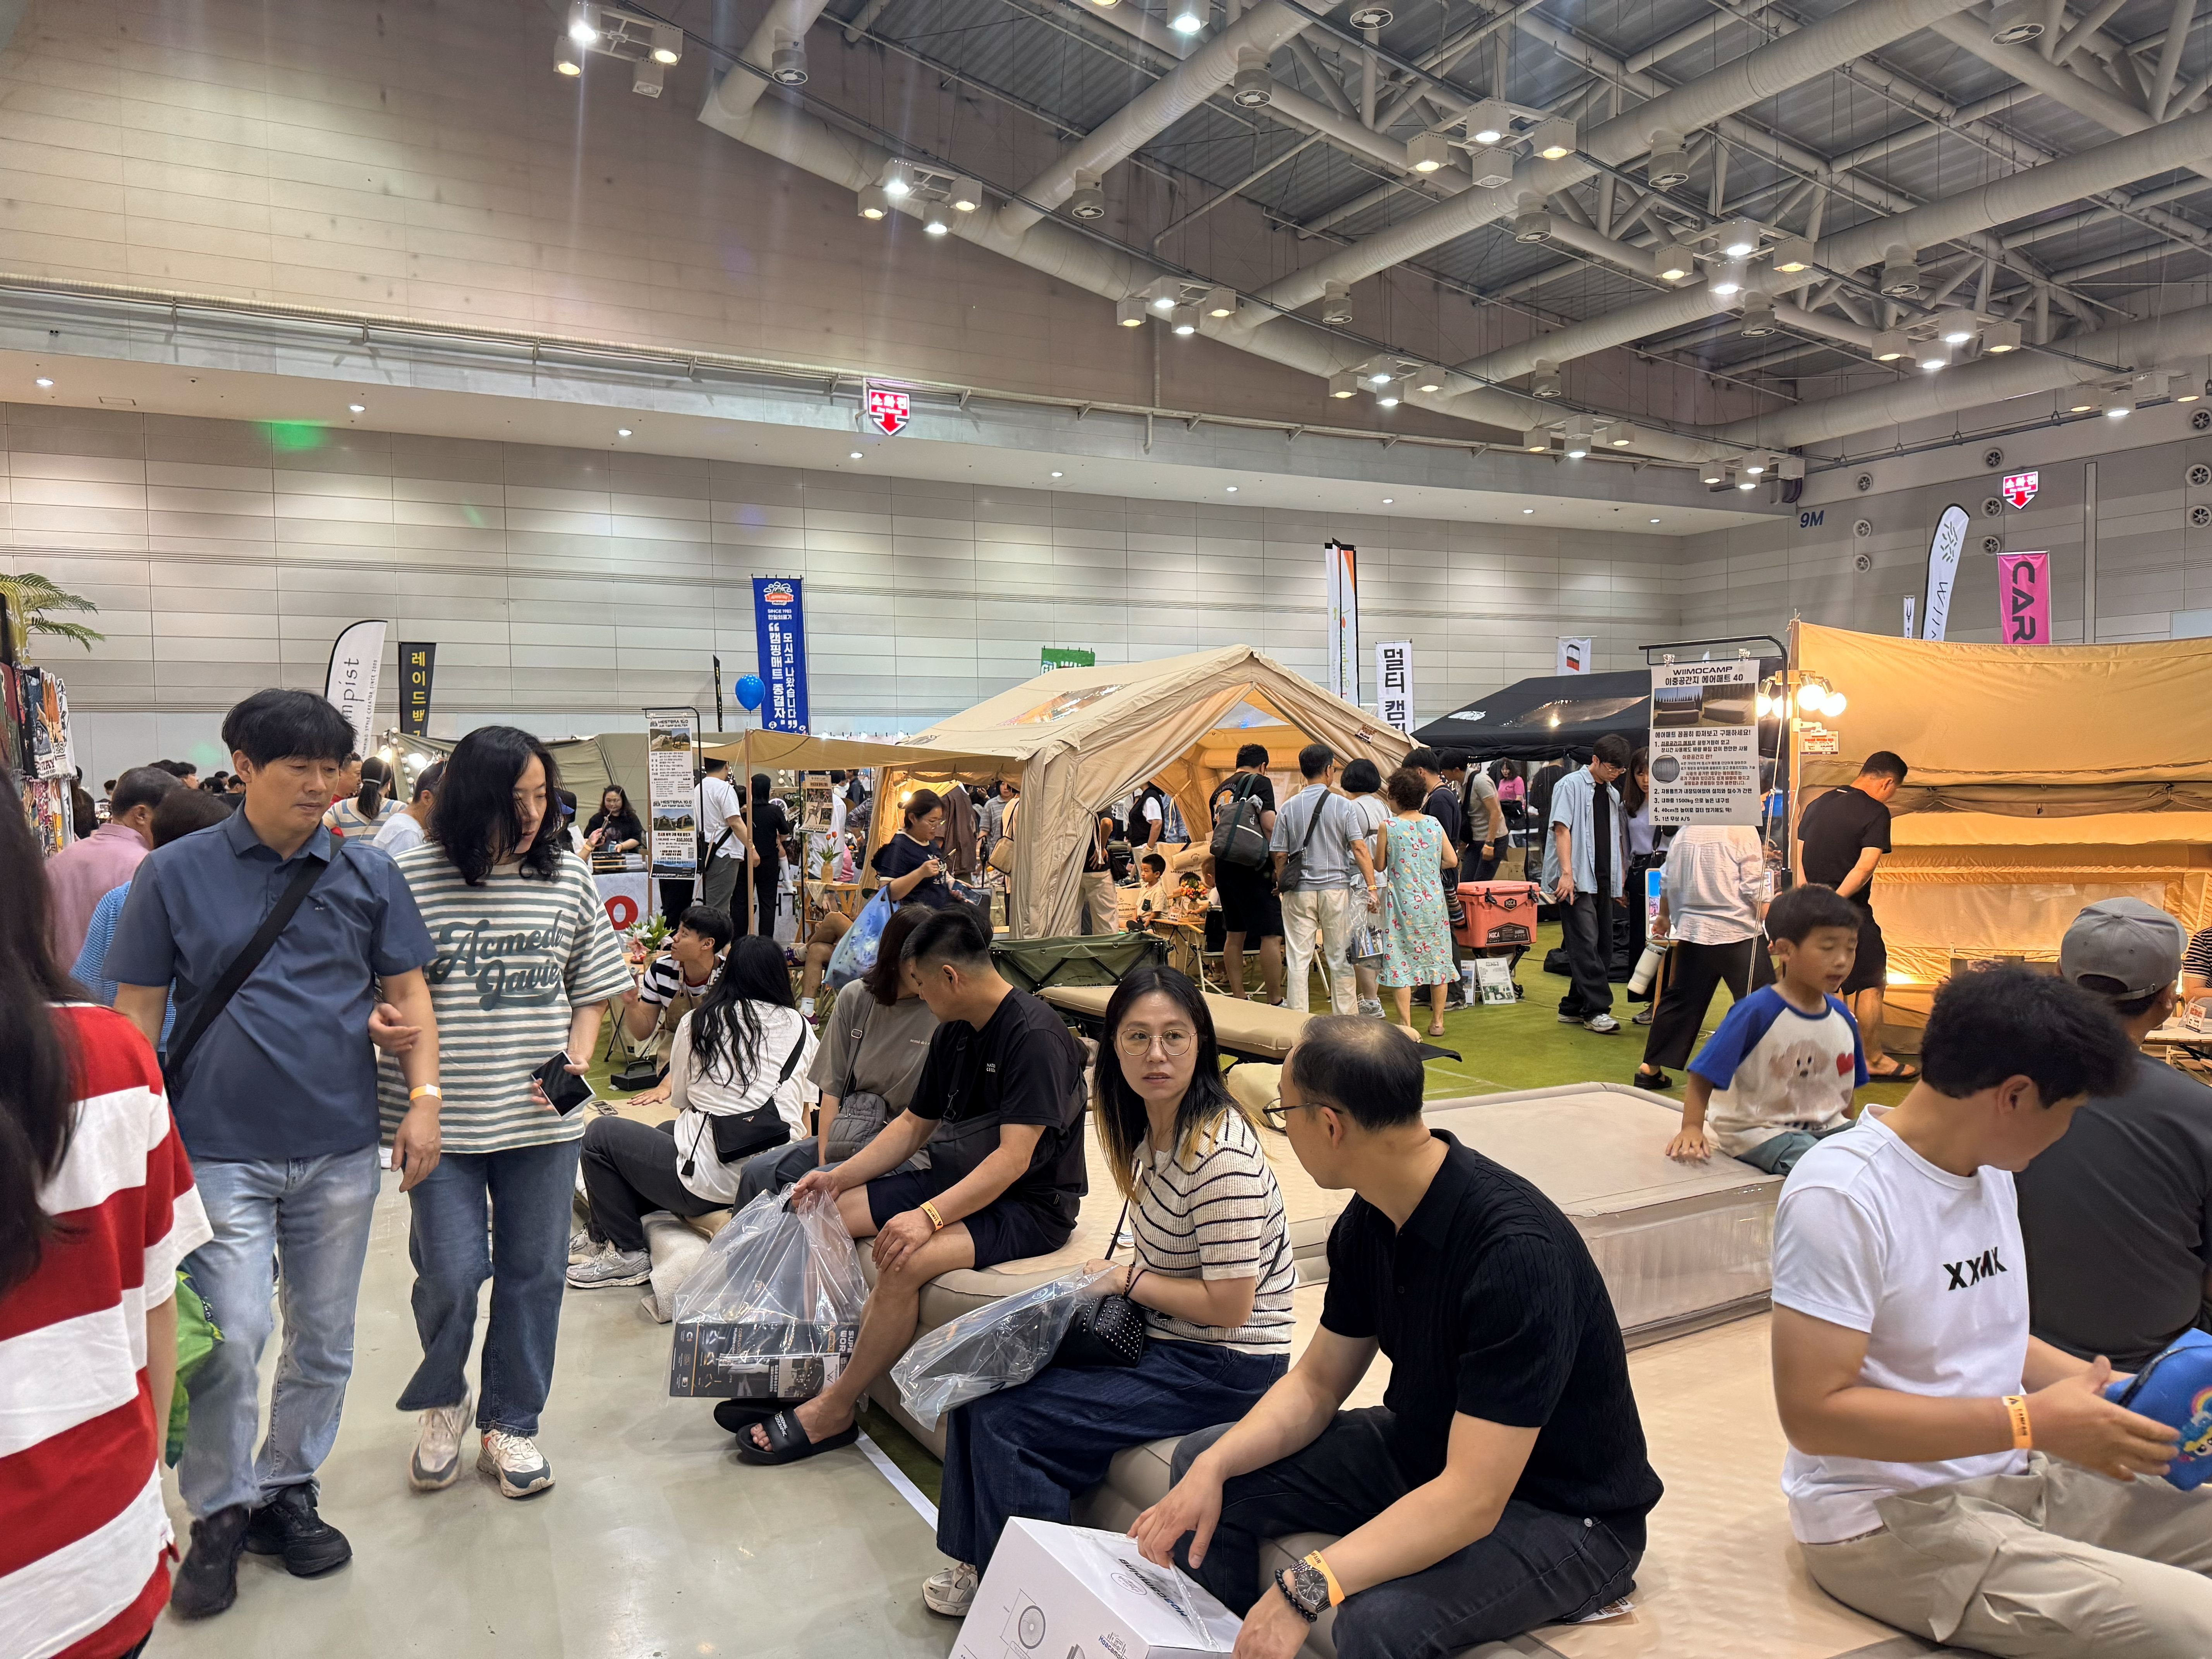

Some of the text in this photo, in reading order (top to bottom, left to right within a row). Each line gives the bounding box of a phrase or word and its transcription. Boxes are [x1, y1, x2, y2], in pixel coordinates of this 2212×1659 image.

[1800, 510, 1824, 528] 9M
[2012, 561, 2036, 644] CAR
[783, 633, 794, 663] 모시고
[338, 658, 364, 720] mpist
[1384, 649, 1405, 693] 멀티
[1665, 676, 1699, 685] 이중공간지
[1702, 674, 1731, 683] 에어매트
[1673, 666, 1733, 675] WIIMOCAMP
[1119, 1558, 1188, 1617] Moacamping
